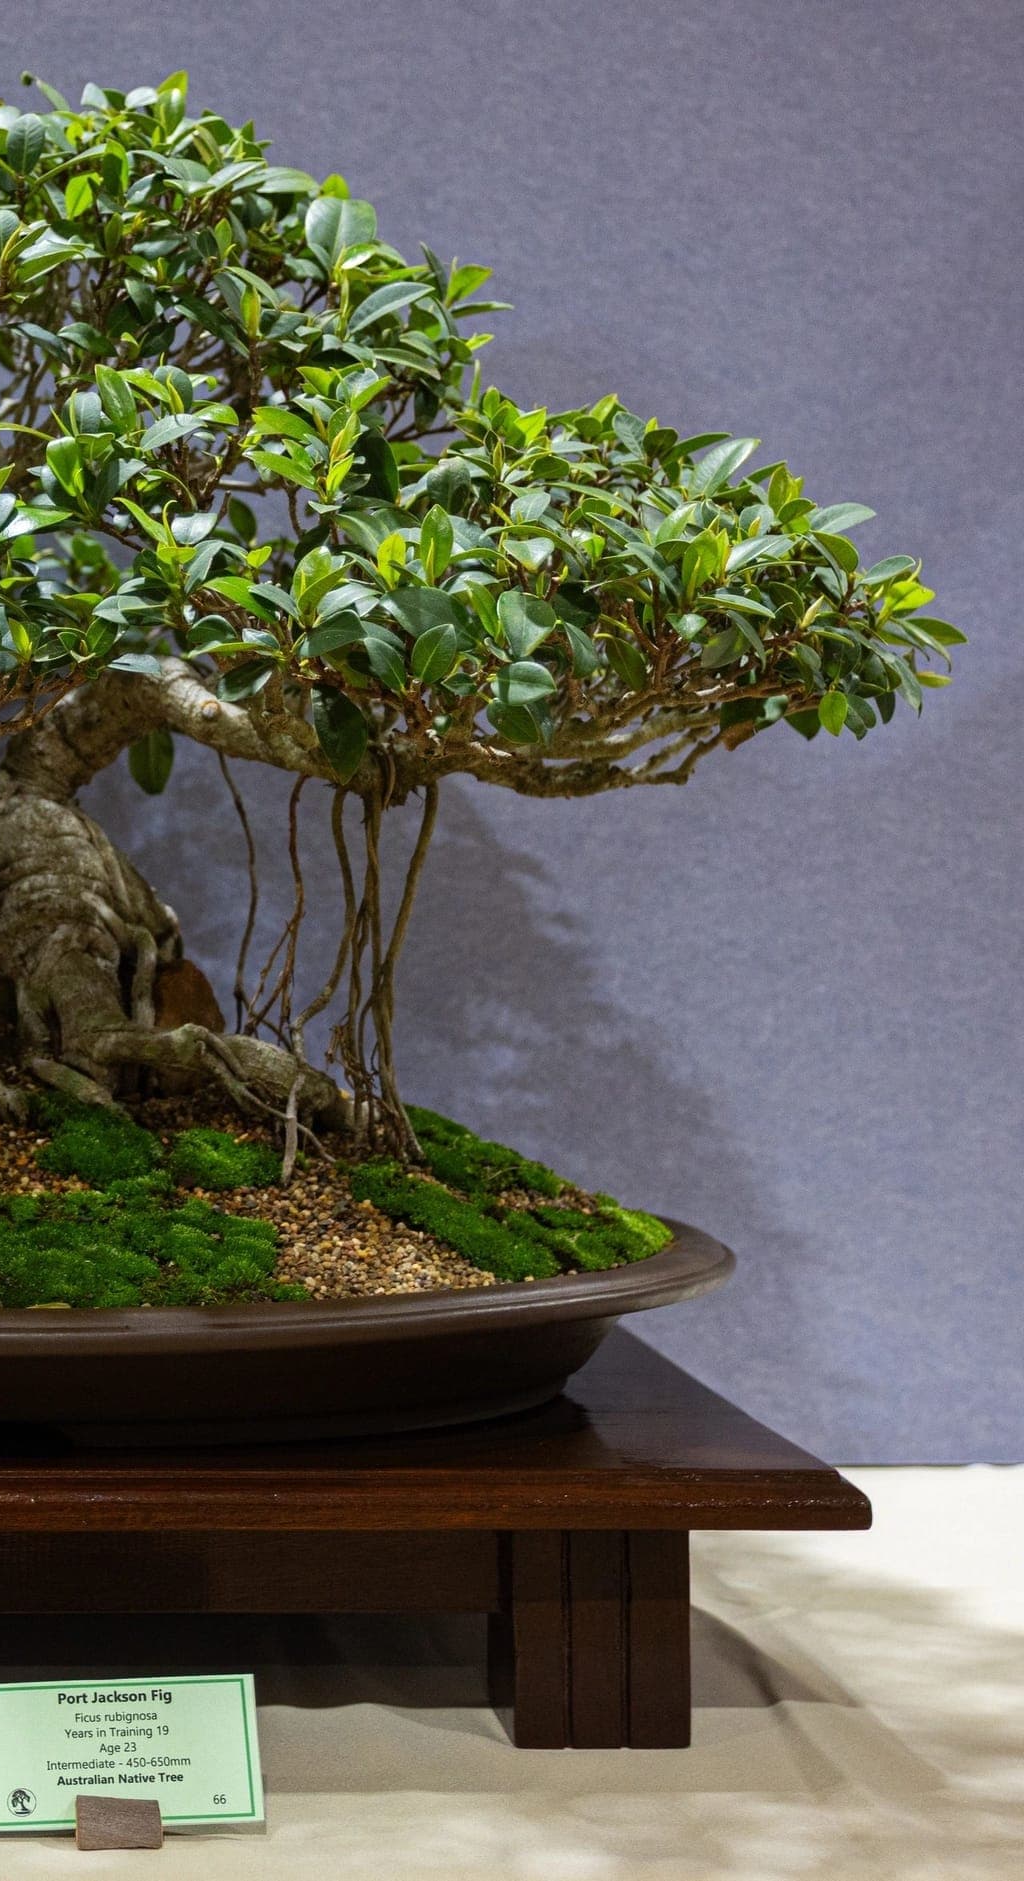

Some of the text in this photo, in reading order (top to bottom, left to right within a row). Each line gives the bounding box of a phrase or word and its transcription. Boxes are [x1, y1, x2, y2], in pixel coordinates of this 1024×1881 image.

[57, 1688, 173, 1705] Port Jackson Fig
[74, 1711, 158, 1724] Ficus rubignosa
[64, 1725, 169, 1739] Years in Training 19
[99, 1741, 137, 1756] Age 23
[46, 1759, 116, 1771] Intermediate
[126, 1756, 191, 1768] 450-650mm
[56, 1772, 184, 1786] Australian Native Tree
[213, 1793, 227, 1805] 66
